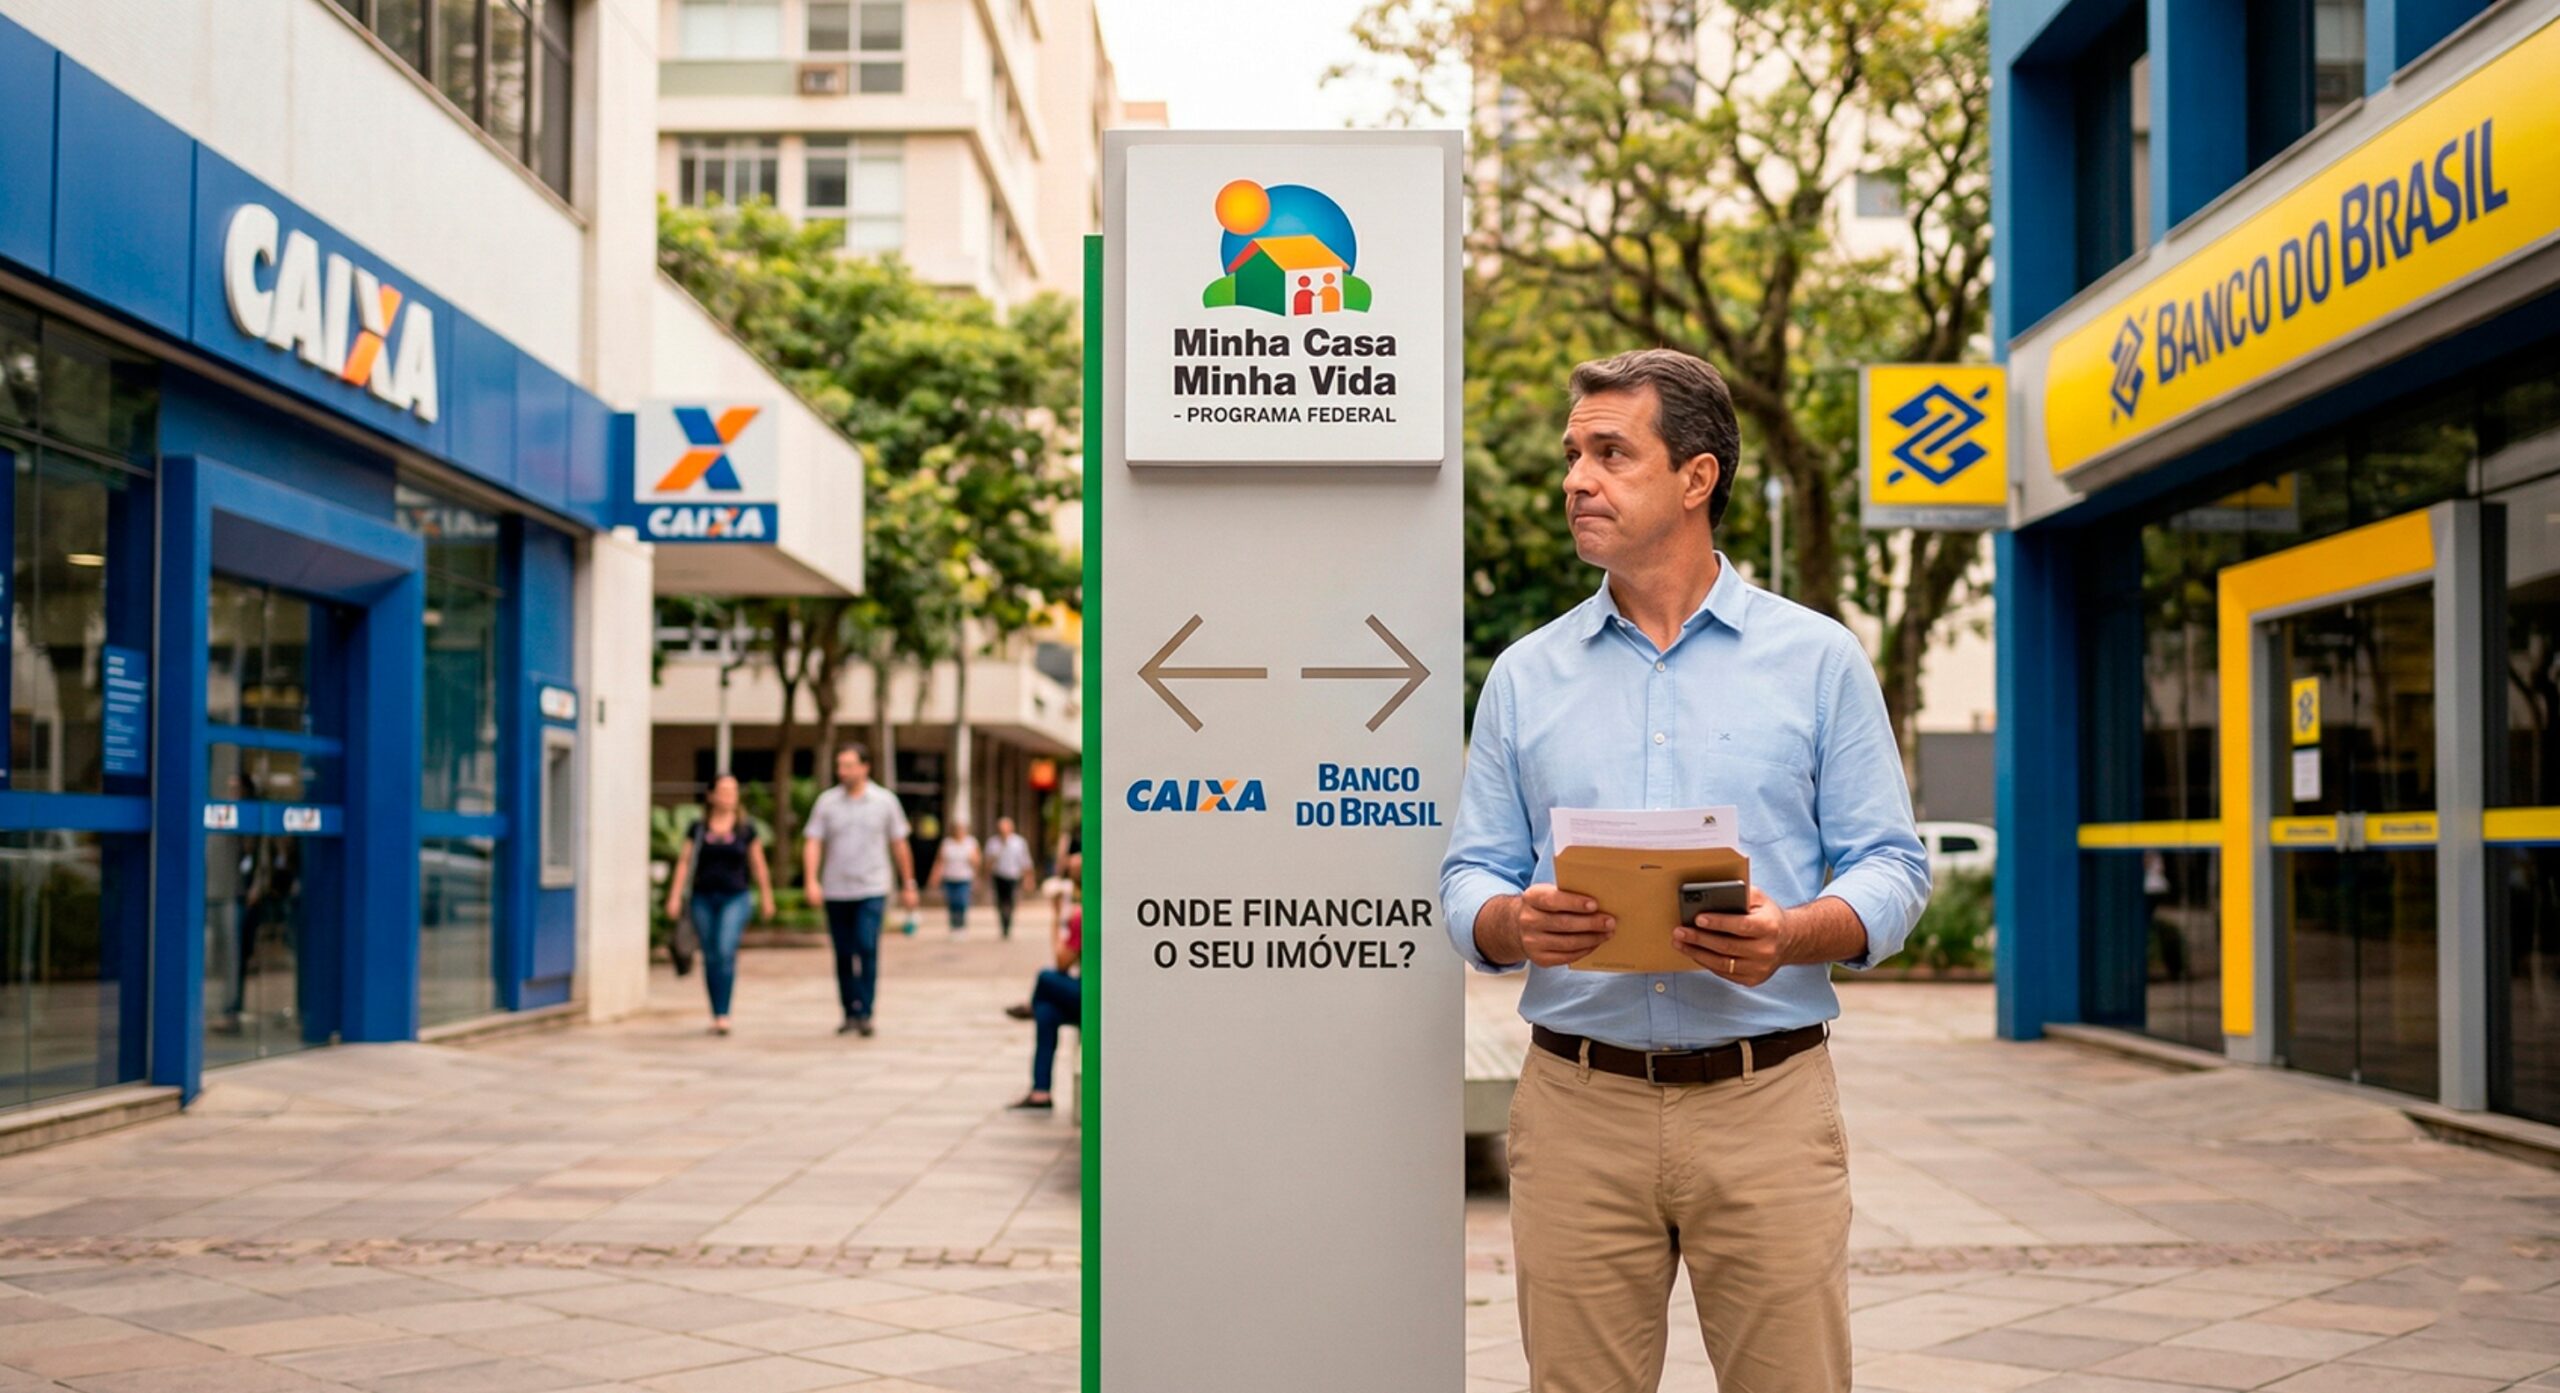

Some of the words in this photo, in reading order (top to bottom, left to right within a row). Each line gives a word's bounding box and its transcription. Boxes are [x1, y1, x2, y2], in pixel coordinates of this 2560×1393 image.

[2155, 254, 2272, 386] BANCO
[2279, 220, 2332, 321] DO
[2340, 117, 2509, 288] BRASIL
[224, 203, 438, 424] CAIXA
[1174, 327, 1290, 357] Minha
[1303, 327, 1397, 358] Casa
[1174, 365, 1297, 396] Minha
[1308, 365, 1397, 396] Vida
[1187, 406, 1302, 423] PROGRAMA
[1307, 406, 1397, 423] FEDERAL
[647, 506, 766, 538] CAIXA
[1318, 763, 1420, 793] BANCO
[1126, 779, 1267, 813] CAIXA
[1296, 801, 1336, 827] DO
[1340, 797, 1443, 827] BRASIL
[1136, 898, 1233, 928] ONDE
[1243, 898, 1433, 927] FINANCIAR
[1153, 940, 1178, 969] O
[1188, 940, 1254, 969] SEU
[1266, 933, 1416, 969] IMÓVEL?
